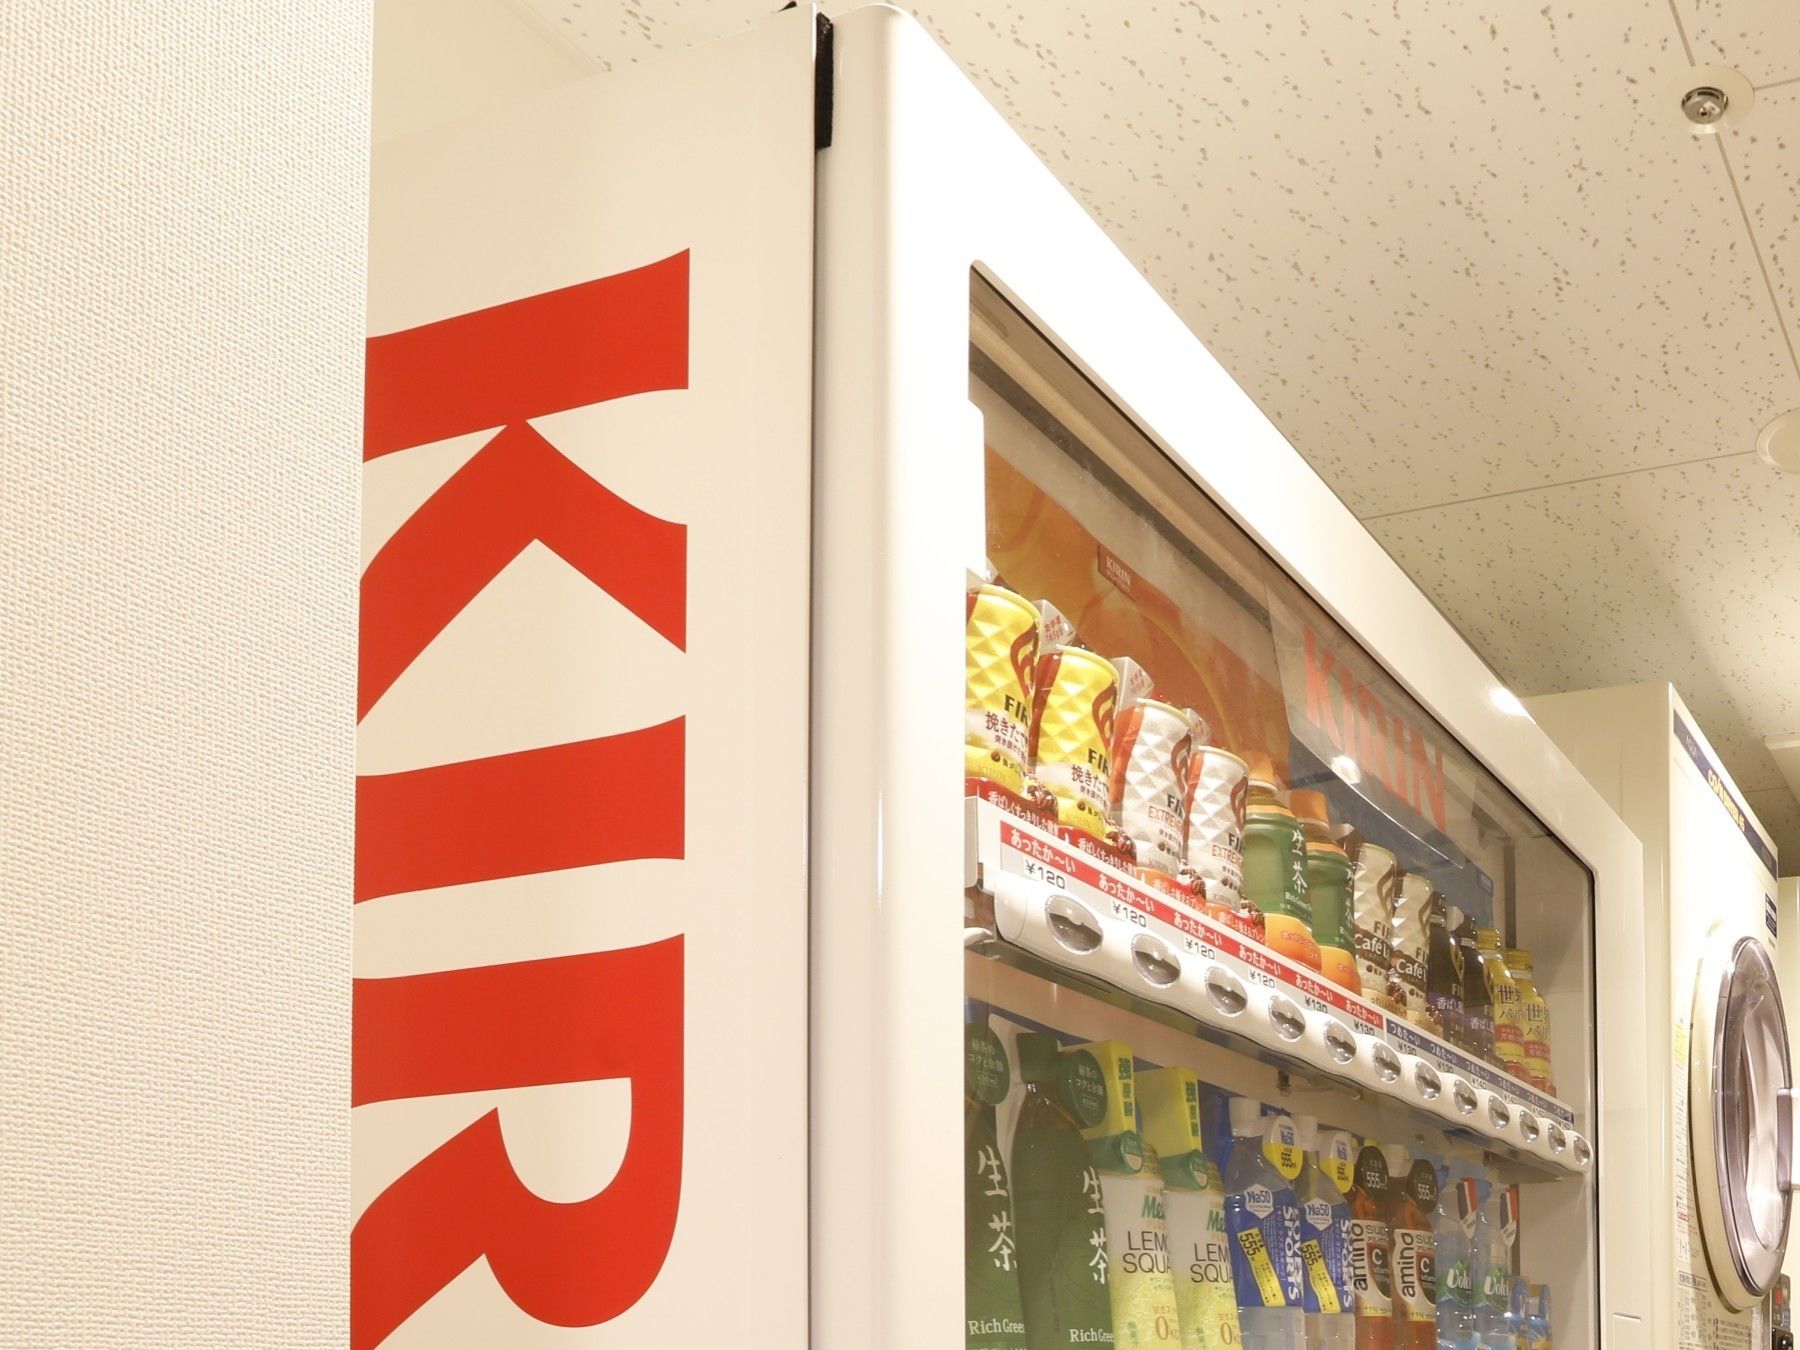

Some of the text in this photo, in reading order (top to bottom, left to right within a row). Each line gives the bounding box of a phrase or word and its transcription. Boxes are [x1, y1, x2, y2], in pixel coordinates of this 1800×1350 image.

[1303, 622, 1447, 833] KIRIN
[1010, 827, 1076, 873] あったか～い
[1025, 859, 1066, 890] ¥120
[1099, 874, 1156, 912] あったか～い
[1112, 901, 1147, 928] ¥120
[1185, 937, 1216, 960] ¥120
[1250, 969, 1276, 988] ¥120
[1304, 995, 1329, 1014] ¥130
[977, 1145, 1018, 1272] 生茶
[1248, 1190, 1272, 1204] Na50
[1308, 1203, 1329, 1216] Na50
[1283, 1205, 1300, 1301] SPORTS
[1352, 1223, 1369, 1292] amino
[1400, 1232, 1416, 1298] amino
[1190, 1264, 1233, 1283] SQU
[968, 1318, 1001, 1335] Rich
[1068, 1328, 1098, 1343] Rich
